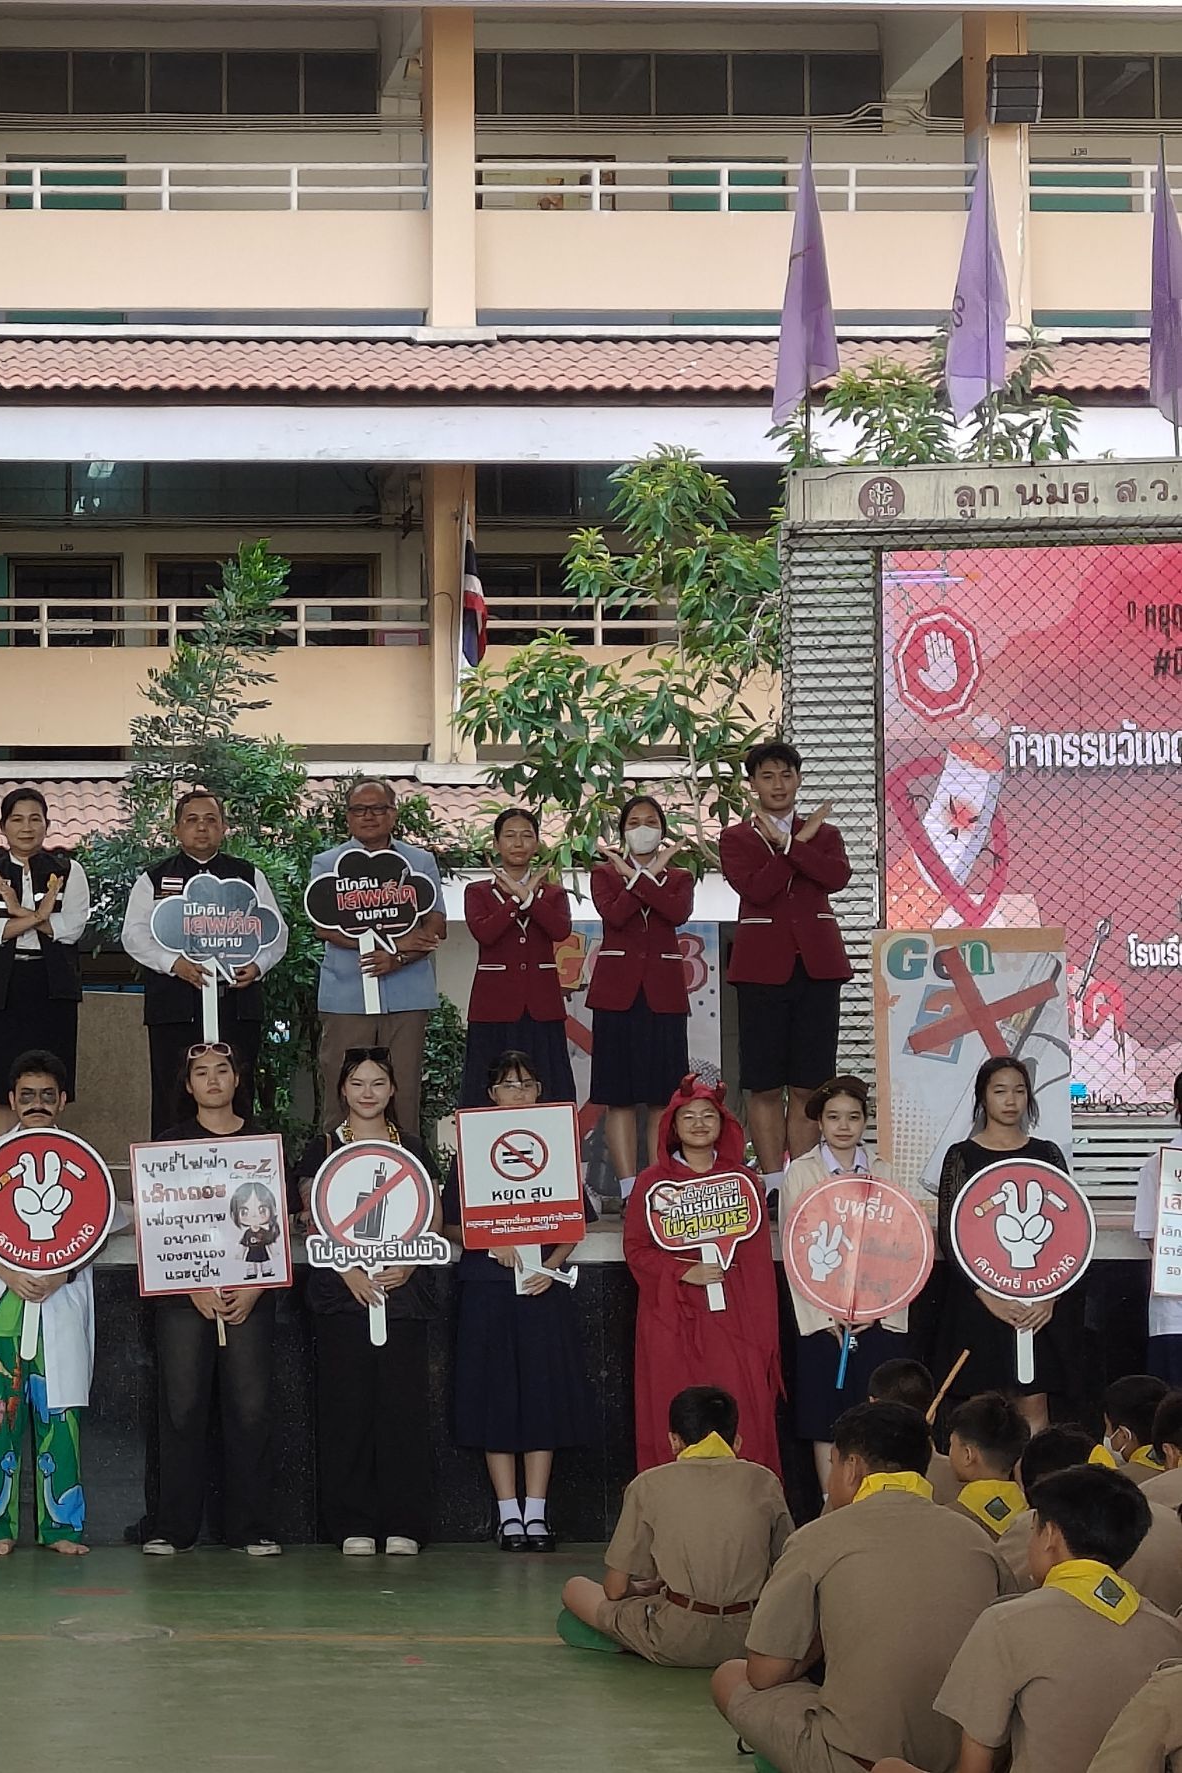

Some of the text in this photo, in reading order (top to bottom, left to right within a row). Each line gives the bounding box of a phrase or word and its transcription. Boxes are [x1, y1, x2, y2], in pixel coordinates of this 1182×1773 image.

[954, 485, 1000, 518] ลูก
[492, 1187, 553, 1205] หยุด สูบ
[313, 1235, 444, 1265] ไม่สูบบุหรี่ไฟฟ้า
